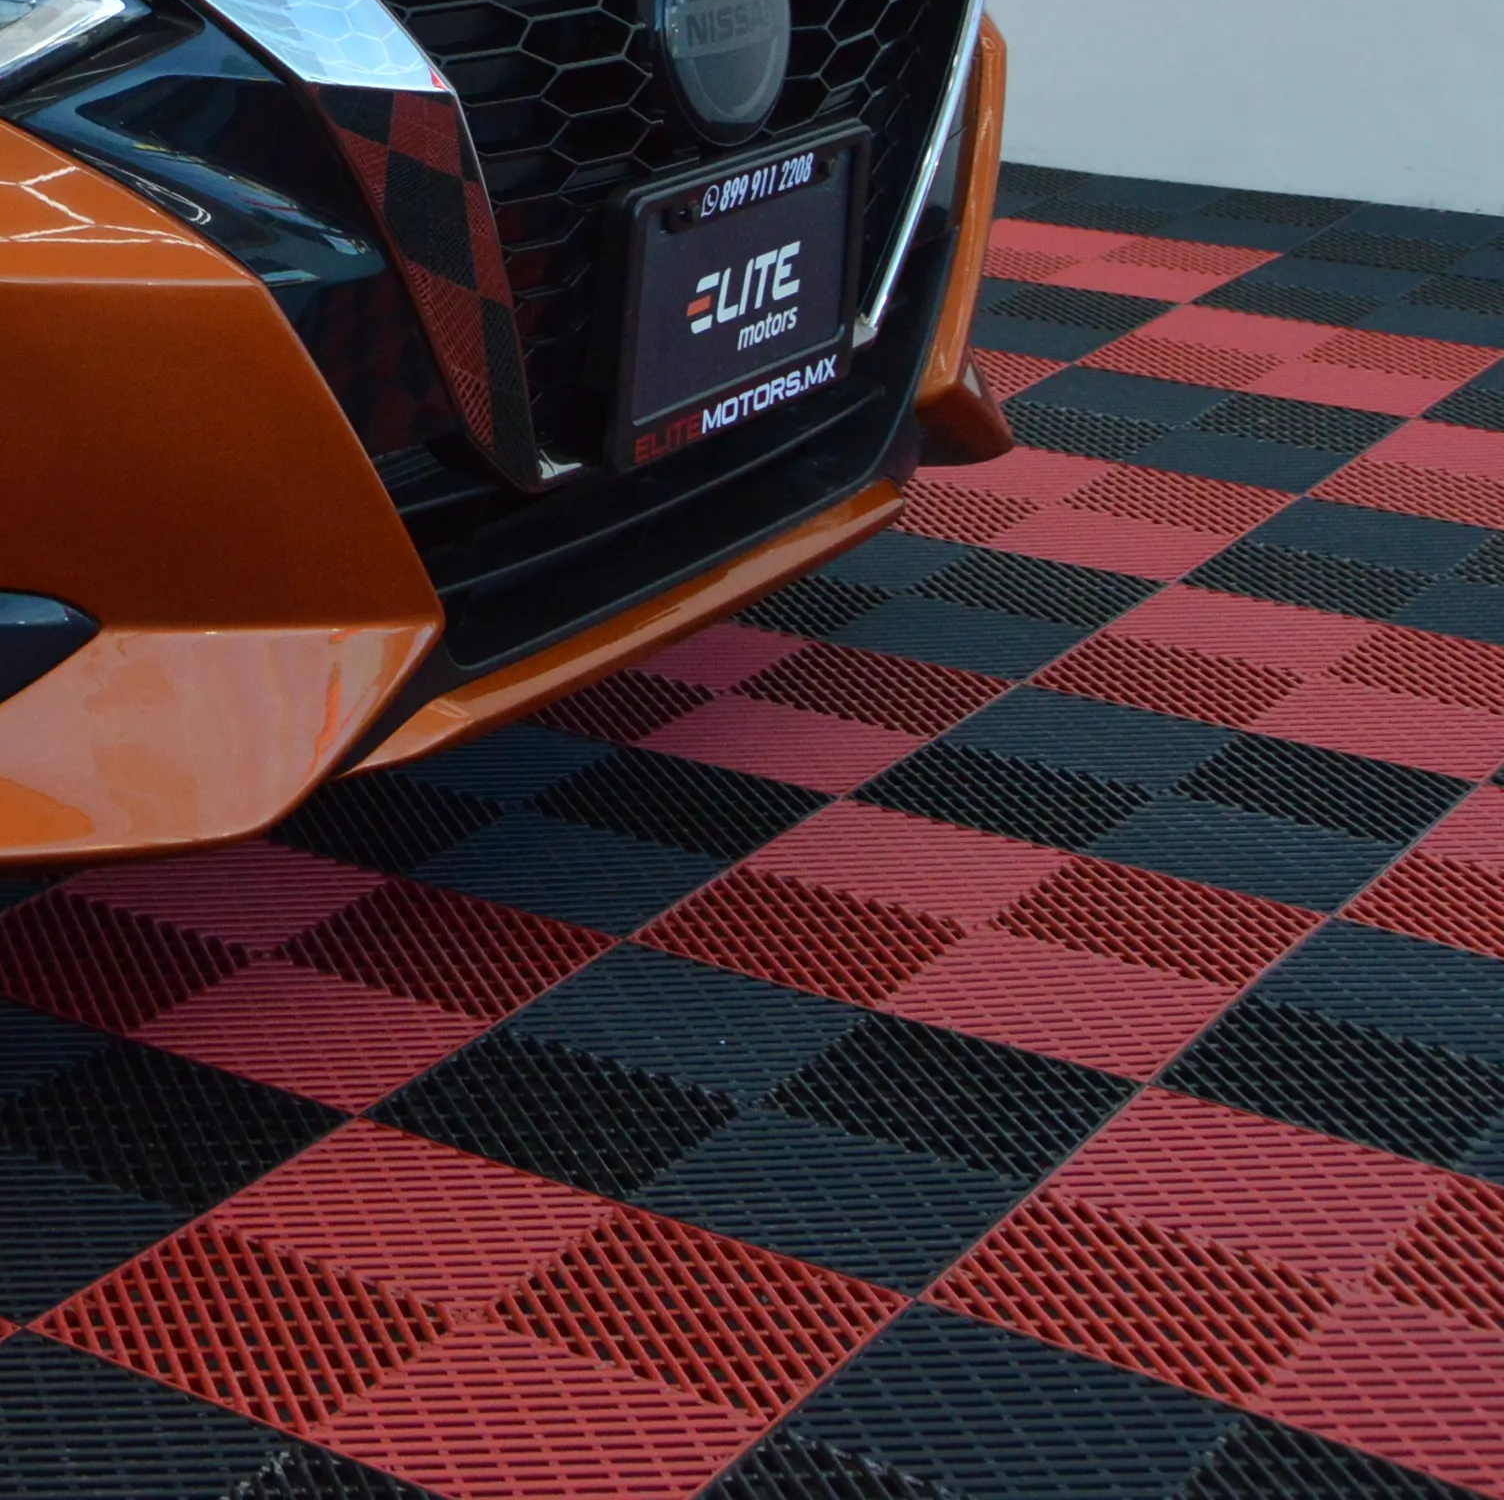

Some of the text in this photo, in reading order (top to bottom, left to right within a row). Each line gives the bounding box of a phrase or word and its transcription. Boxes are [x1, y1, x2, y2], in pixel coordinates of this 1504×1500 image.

[719, 151, 814, 212] 899 911 2208
[686, 240, 801, 335] ELITE
[736, 305, 798, 351] motors
